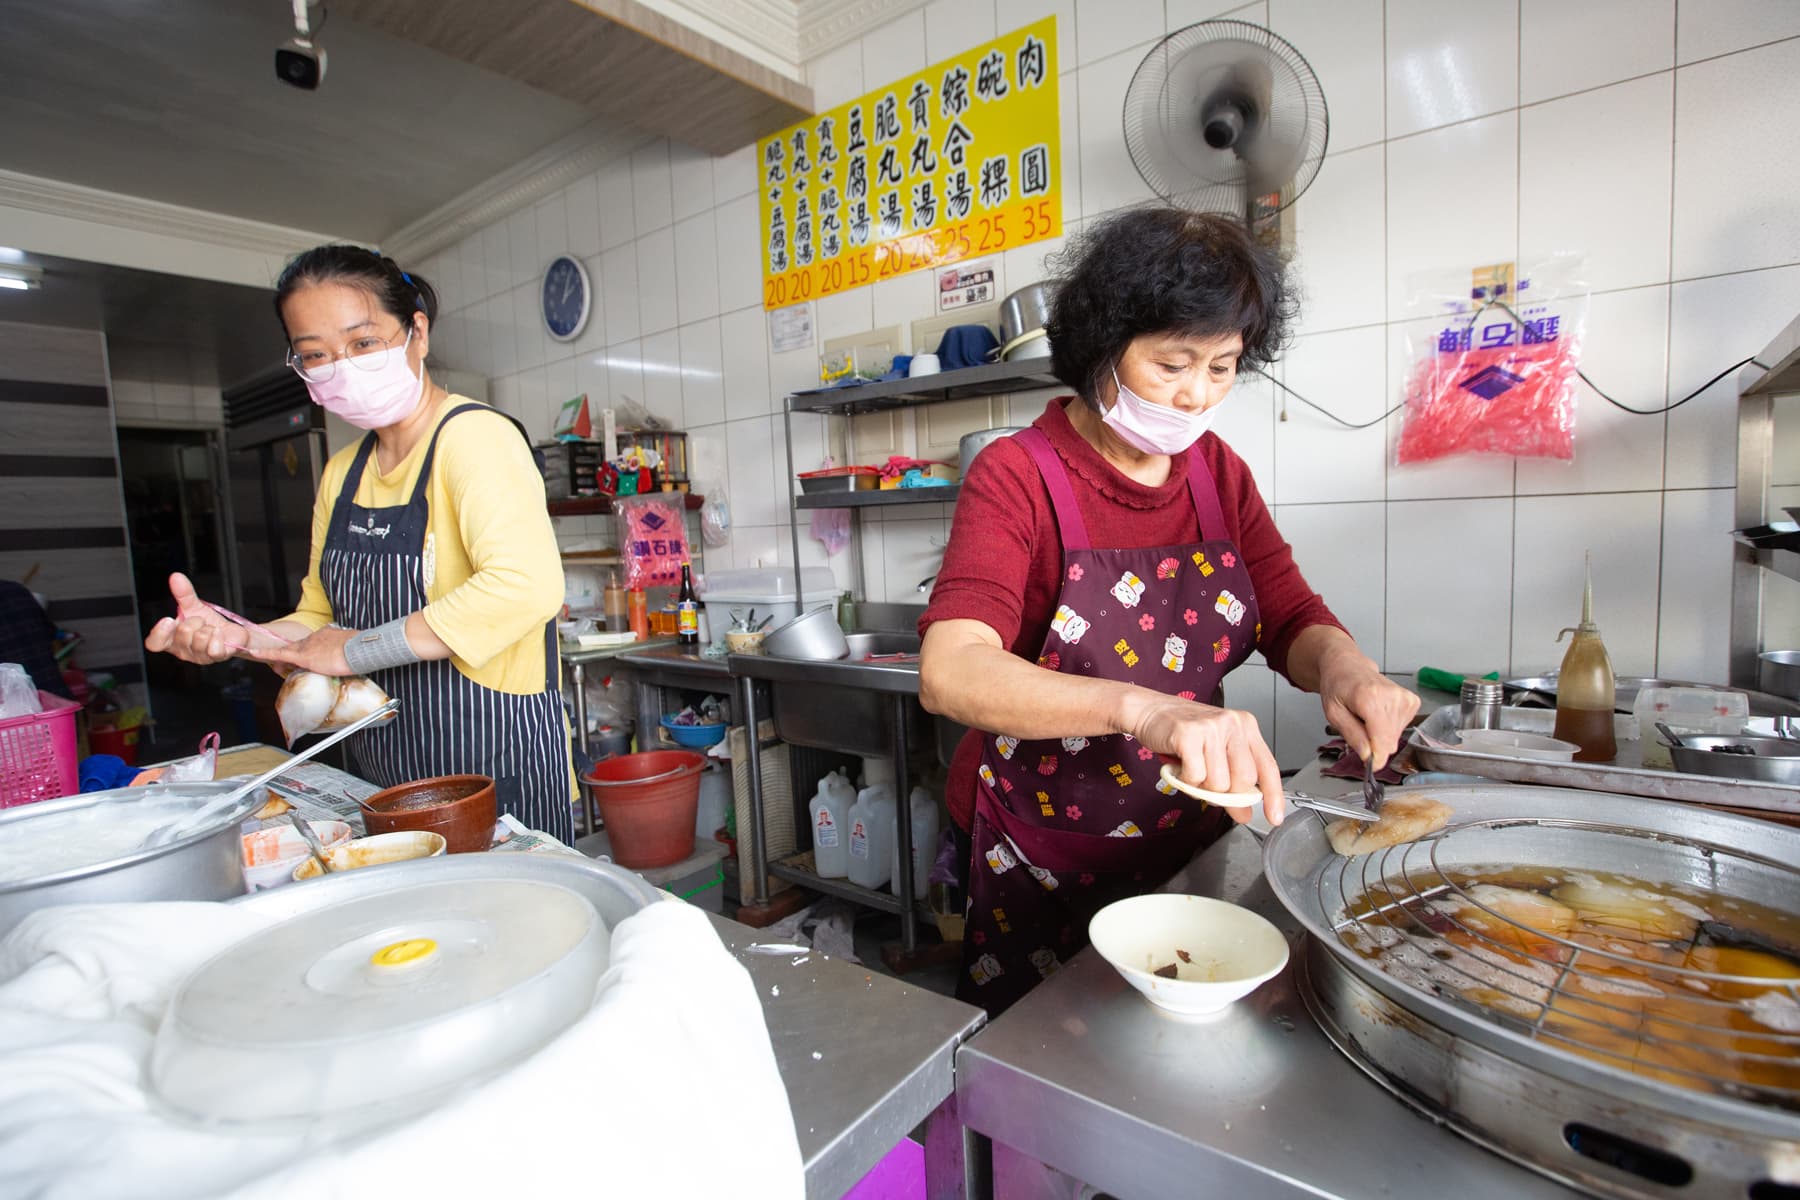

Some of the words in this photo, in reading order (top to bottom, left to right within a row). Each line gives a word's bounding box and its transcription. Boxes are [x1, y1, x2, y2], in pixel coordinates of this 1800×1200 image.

[908, 82, 936, 228] 貢丸湯
[942, 66, 972, 217] 綜合湯
[847, 107, 871, 244] 豆腐湯
[875, 96, 902, 236] 脆丸湯
[766, 139, 788, 273] 脆丸+豆腐湯
[792, 130, 813, 265] 貢丸+豆腐湯
[818, 119, 840, 258] 貢丸+脆丸湯
[979, 215, 1006, 252] 25
[1023, 201, 1051, 240] 35
[879, 242, 903, 276] 20
[945, 223, 970, 260] 25
[790, 269, 811, 301] 20
[821, 260, 842, 294] 20
[848, 253, 870, 286] 15
[766, 276, 787, 307] 20
